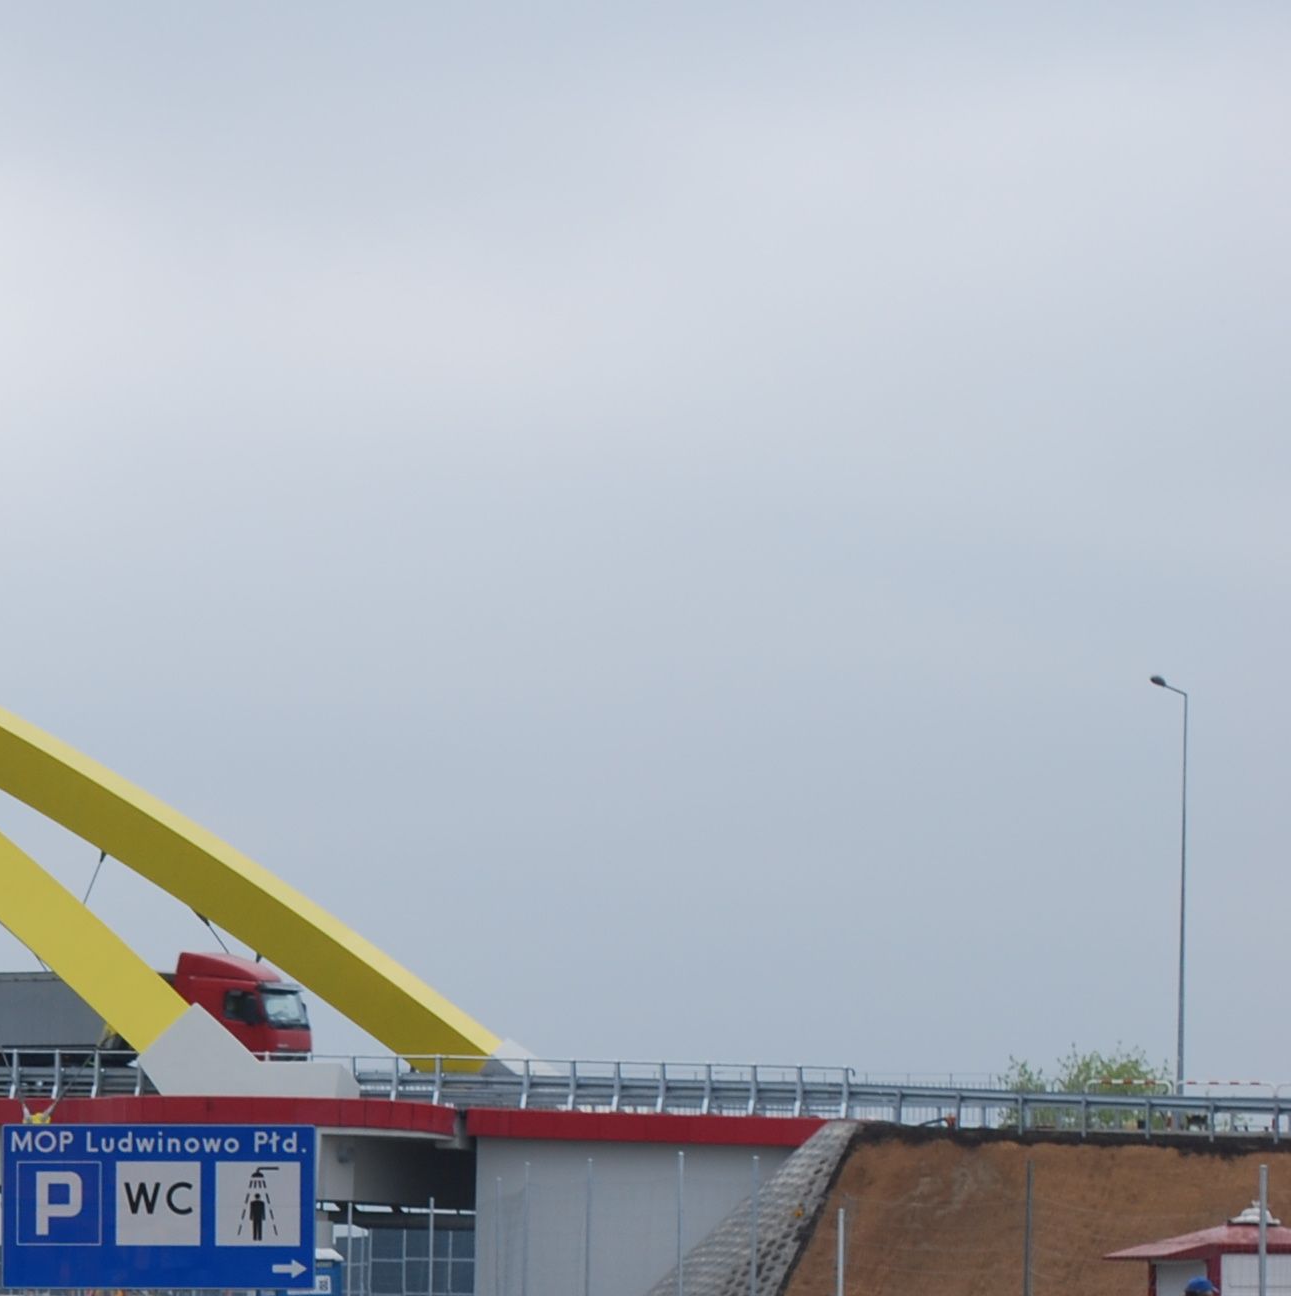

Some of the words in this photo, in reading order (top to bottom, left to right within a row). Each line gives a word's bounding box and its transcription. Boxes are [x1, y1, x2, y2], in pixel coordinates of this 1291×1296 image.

[11, 1131, 73, 1153] MOP
[86, 1131, 240, 1153] Ludwinowo
[253, 1131, 308, 1153] Płd.
[36, 1171, 83, 1236] P
[124, 1182, 193, 1215] WC
